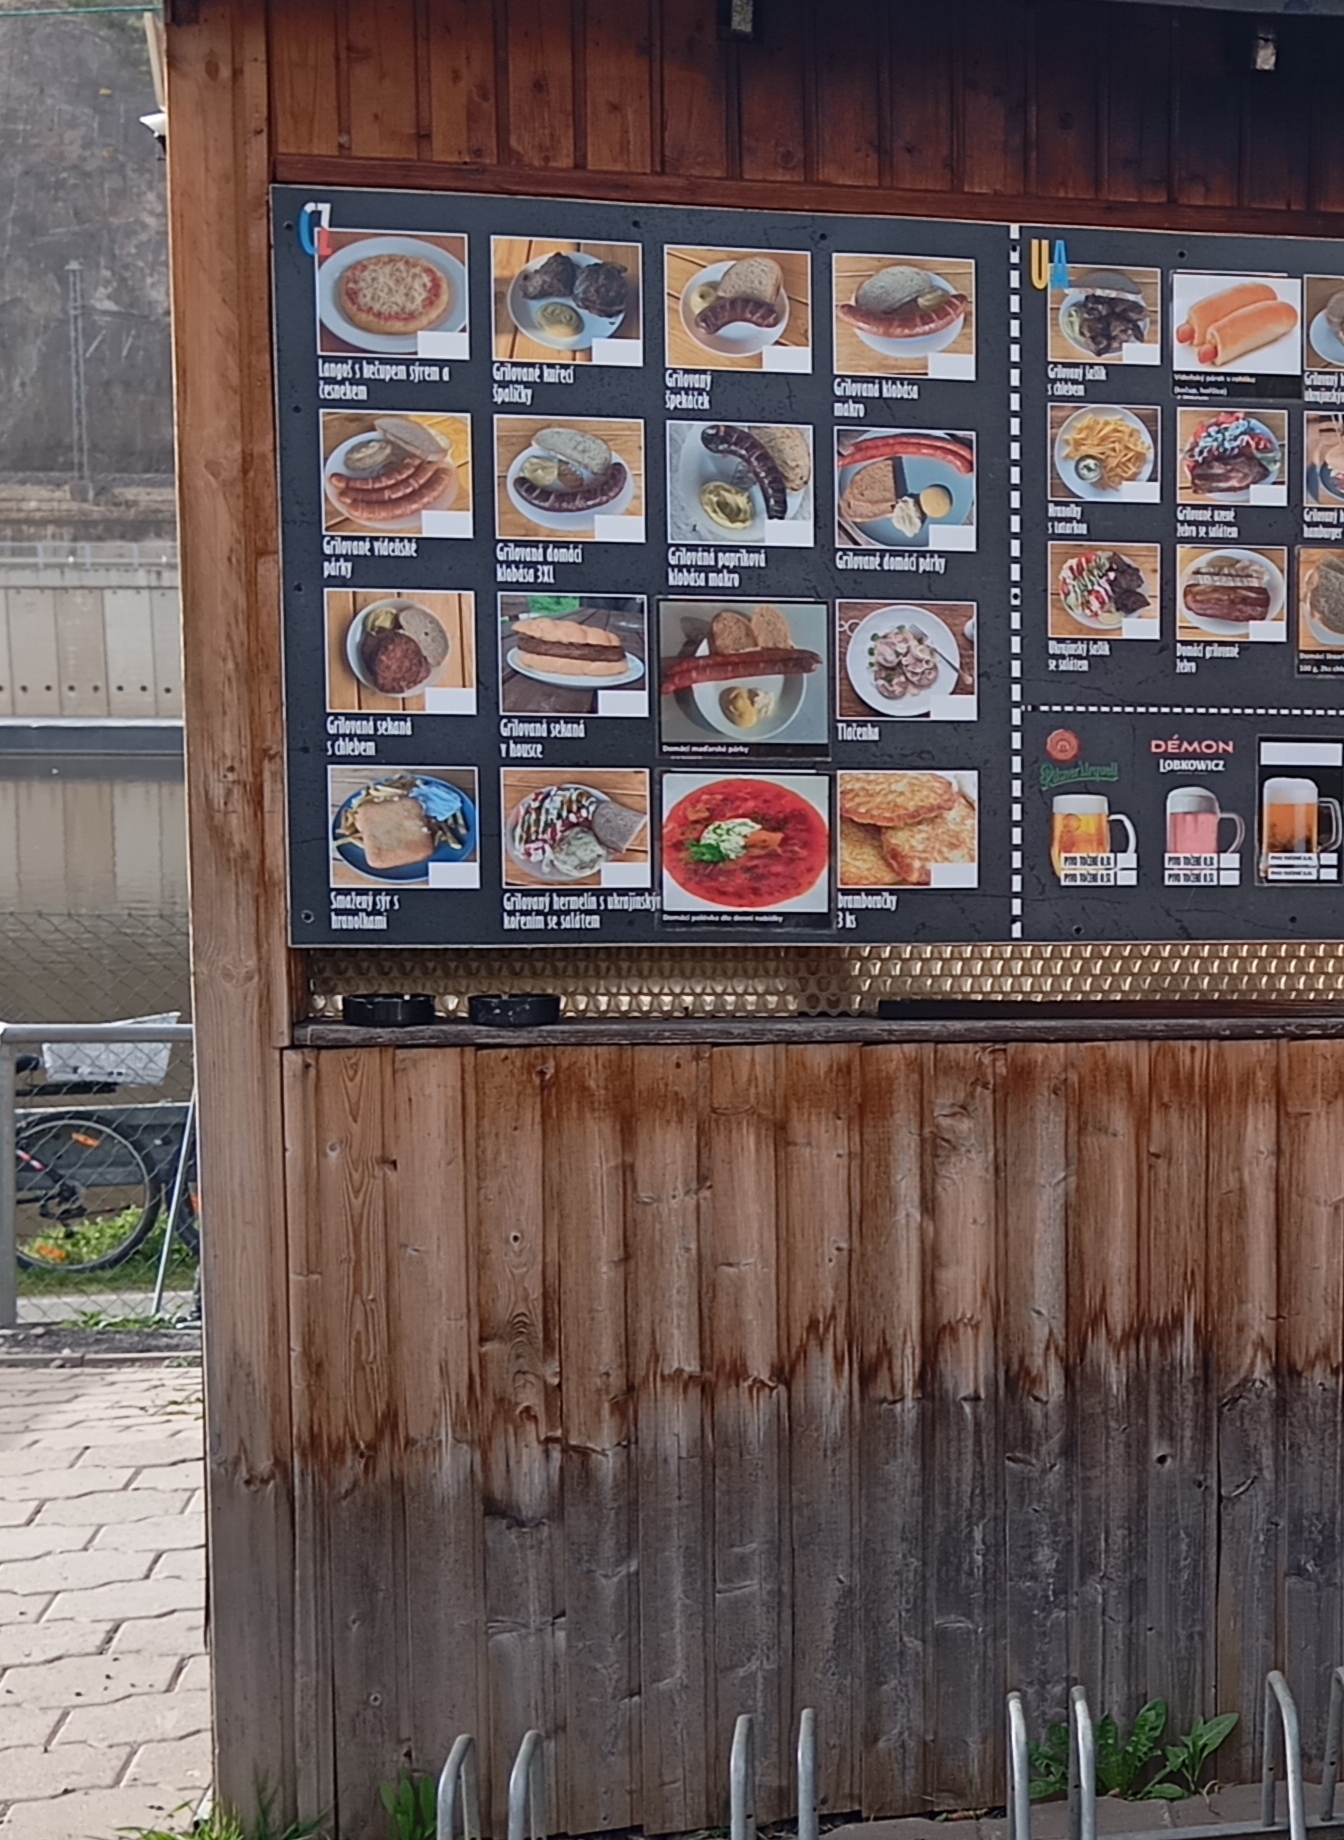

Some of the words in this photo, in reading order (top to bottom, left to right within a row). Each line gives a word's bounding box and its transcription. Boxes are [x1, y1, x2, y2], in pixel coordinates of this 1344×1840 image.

[299, 202, 332, 256] CZ
[1029, 238, 1069, 291] UA
[319, 358, 353, 380] Langoš
[355, 363, 360, 378] s
[362, 360, 407, 381] kečupem
[409, 363, 440, 382] sýrem
[442, 366, 450, 380] a
[492, 363, 540, 382] Grilované
[543, 365, 574, 383] kuřecí
[665, 370, 712, 390] Grilovaný
[1047, 364, 1083, 381] Grilovaný
[319, 381, 368, 400] česnekem
[492, 384, 533, 405] špaličky
[834, 378, 880, 398] Grilovaná
[882, 379, 919, 399] klobása
[1047, 383, 1052, 395] s
[1053, 381, 1085, 396] chlebem
[665, 390, 711, 410] špekáček
[834, 399, 865, 418] makro
[1048, 522, 1052, 534] s
[323, 537, 371, 557] Grilované
[373, 539, 418, 557] vídeňské
[496, 543, 543, 562] Grilovaná
[546, 544, 583, 563] domácí
[323, 558, 353, 578] párky
[717, 549, 767, 568] papriková
[836, 551, 881, 570] Grilované
[883, 552, 917, 571] domácí
[918, 554, 947, 574] párky
[496, 564, 535, 582] klobása
[537, 565, 555, 584] 3XL
[668, 568, 706, 587] klobása
[707, 569, 740, 587] makro
[327, 716, 374, 735] Grilovaná
[376, 717, 412, 736] sekaná
[500, 718, 548, 738] Grilovaná
[550, 719, 586, 738] sekaná
[836, 723, 880, 741] Tlačenka
[327, 741, 332, 756] s
[335, 738, 376, 756] chlebem
[500, 742, 506, 758] v
[509, 740, 543, 759] housce
[1151, 734, 1234, 753] DÉMON
[1159, 758, 1226, 773] LOBKOWICZ
[330, 891, 373, 912] Smažený
[375, 892, 391, 912] sýr
[393, 895, 399, 910] s
[503, 892, 550, 912] Grilovaný
[552, 893, 597, 910] hermelín
[599, 895, 605, 910] s
[331, 912, 387, 930] hranolkami
[503, 913, 545, 930] kořením
[547, 915, 559, 930] se
[560, 913, 601, 930] salátem
[845, 911, 856, 929] ks
